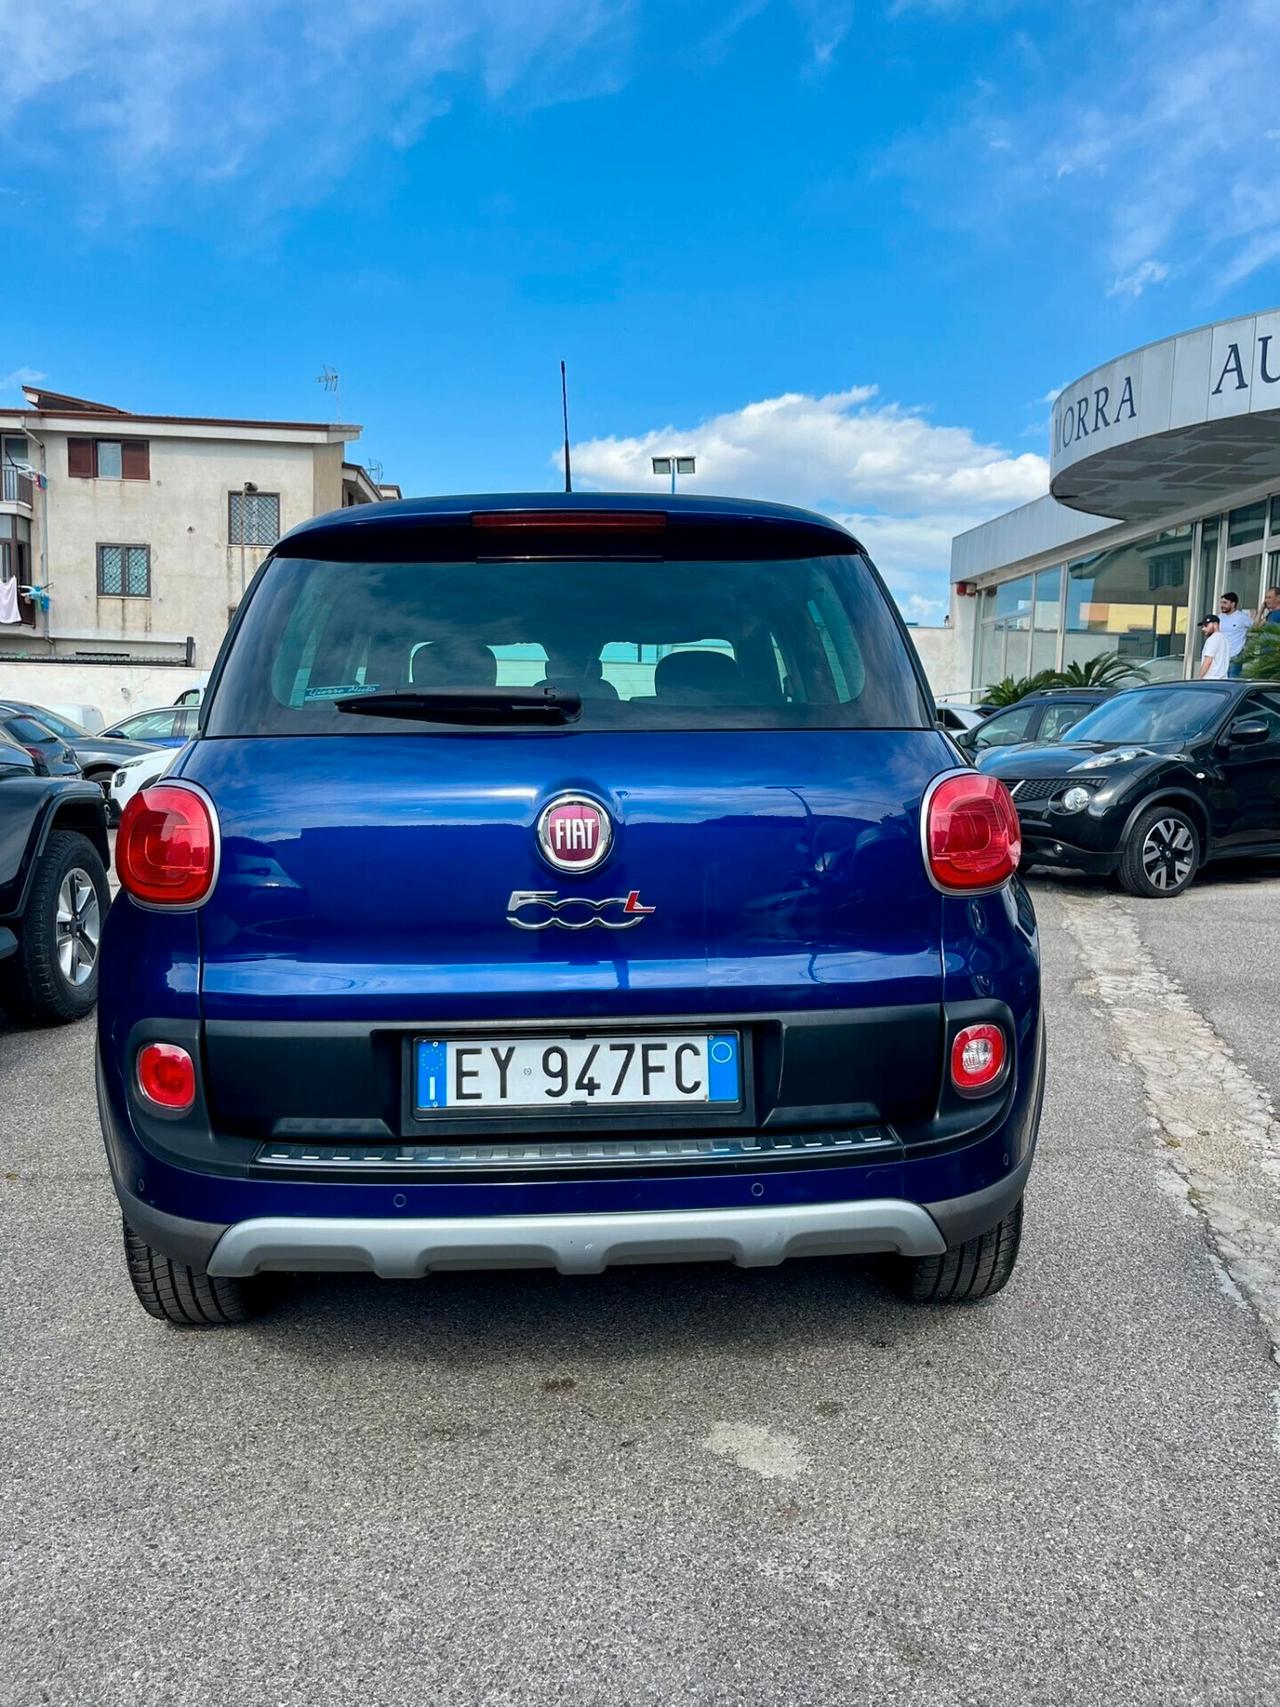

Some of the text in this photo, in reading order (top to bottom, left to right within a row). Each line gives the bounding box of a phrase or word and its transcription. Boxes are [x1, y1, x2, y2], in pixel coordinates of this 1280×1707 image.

[556, 819, 596, 850] FIAT
[506, 890, 657, 930] 500L
[455, 1043, 702, 1100] EY 947FC
